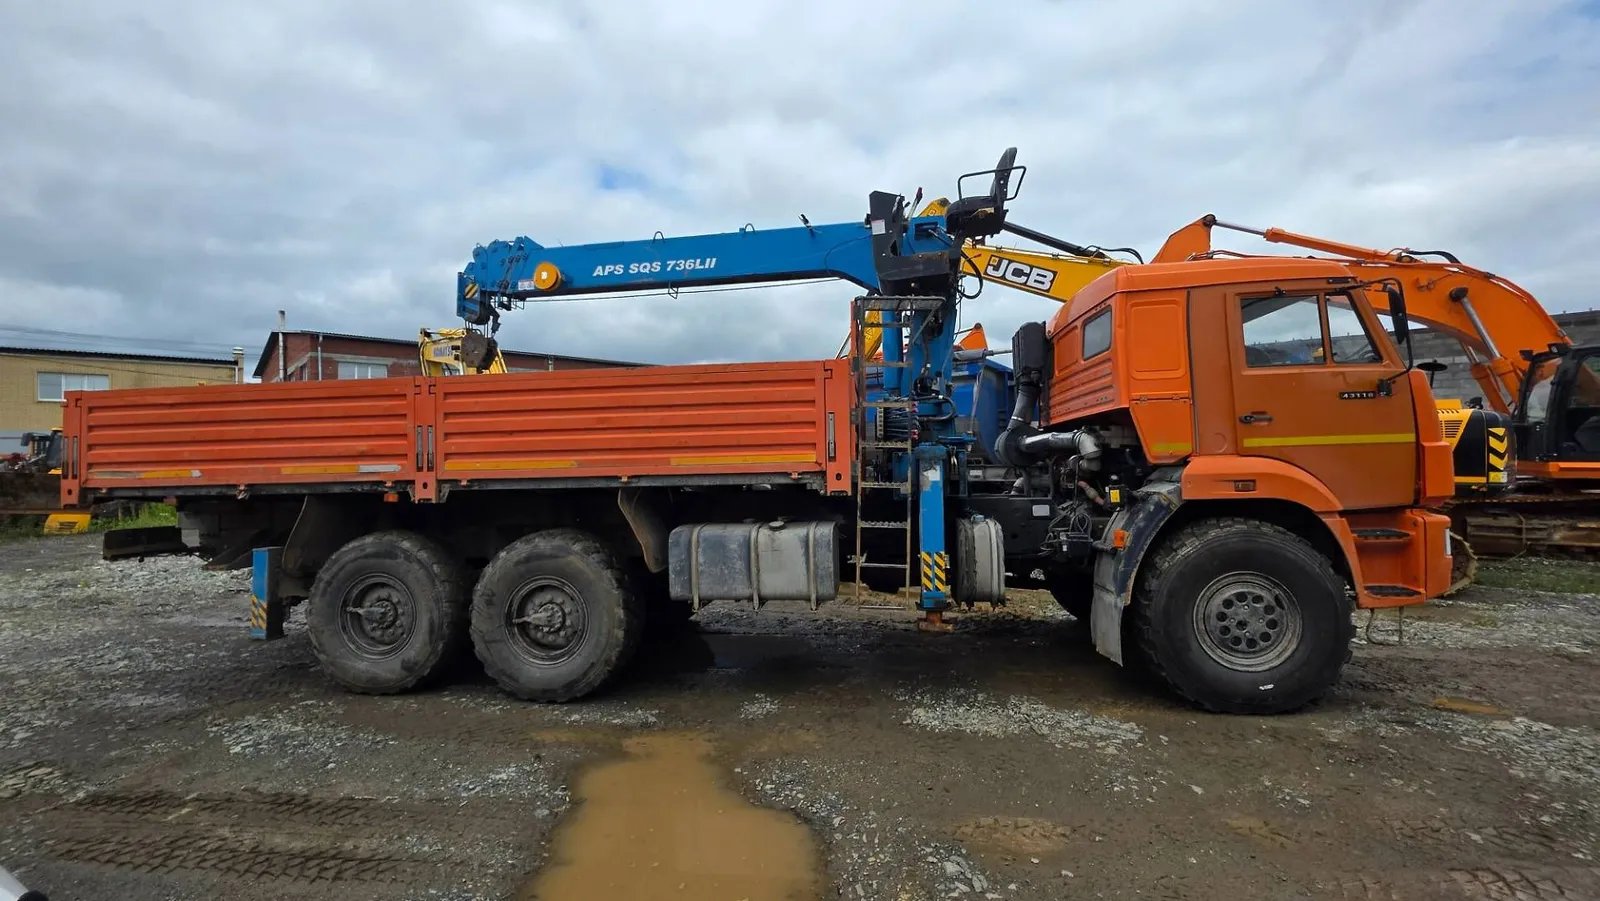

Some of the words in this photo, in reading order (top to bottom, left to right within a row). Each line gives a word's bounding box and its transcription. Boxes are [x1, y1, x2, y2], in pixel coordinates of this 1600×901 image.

[592, 265, 624, 276] APS
[628, 261, 661, 273] SQS
[666, 258, 717, 271] 736LII
[986, 256, 1054, 290] JCB
